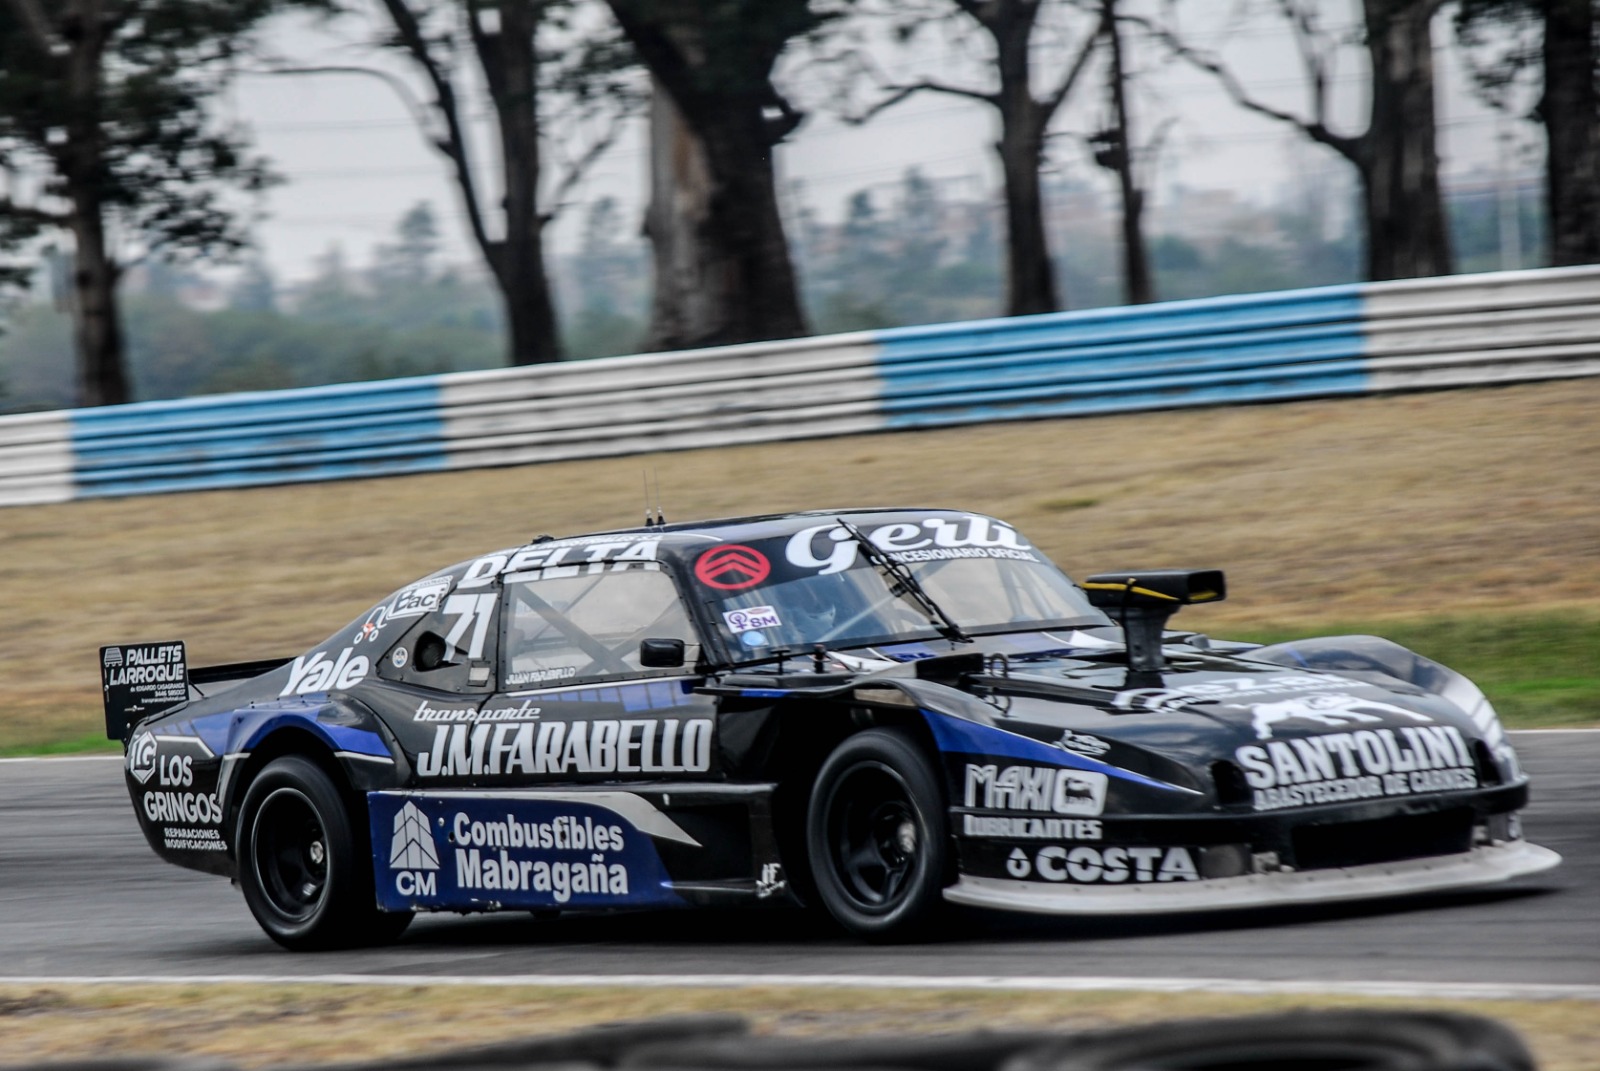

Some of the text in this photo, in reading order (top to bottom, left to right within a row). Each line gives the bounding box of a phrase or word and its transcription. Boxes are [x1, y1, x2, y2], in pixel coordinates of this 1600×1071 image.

[456, 540, 662, 589] DELTA
[986, 548, 1041, 563] OFICIAL
[442, 592, 498, 663] 71
[126, 645, 182, 666] PALLETS
[279, 647, 370, 697] Yale
[109, 663, 185, 686] LARROQUE
[413, 701, 541, 722] transporte
[160, 754, 194, 787] LOS
[1235, 725, 1475, 789] SANTOLINI
[1383, 773, 1411, 796] DE
[144, 791, 223, 824] GRINGOS
[164, 827, 220, 839] REPARACIONES
[453, 812, 625, 851] Combustibles
[456, 848, 629, 902] Mabragaña
[1035, 846, 1200, 882] COSTA
[396, 871, 437, 896] CM
